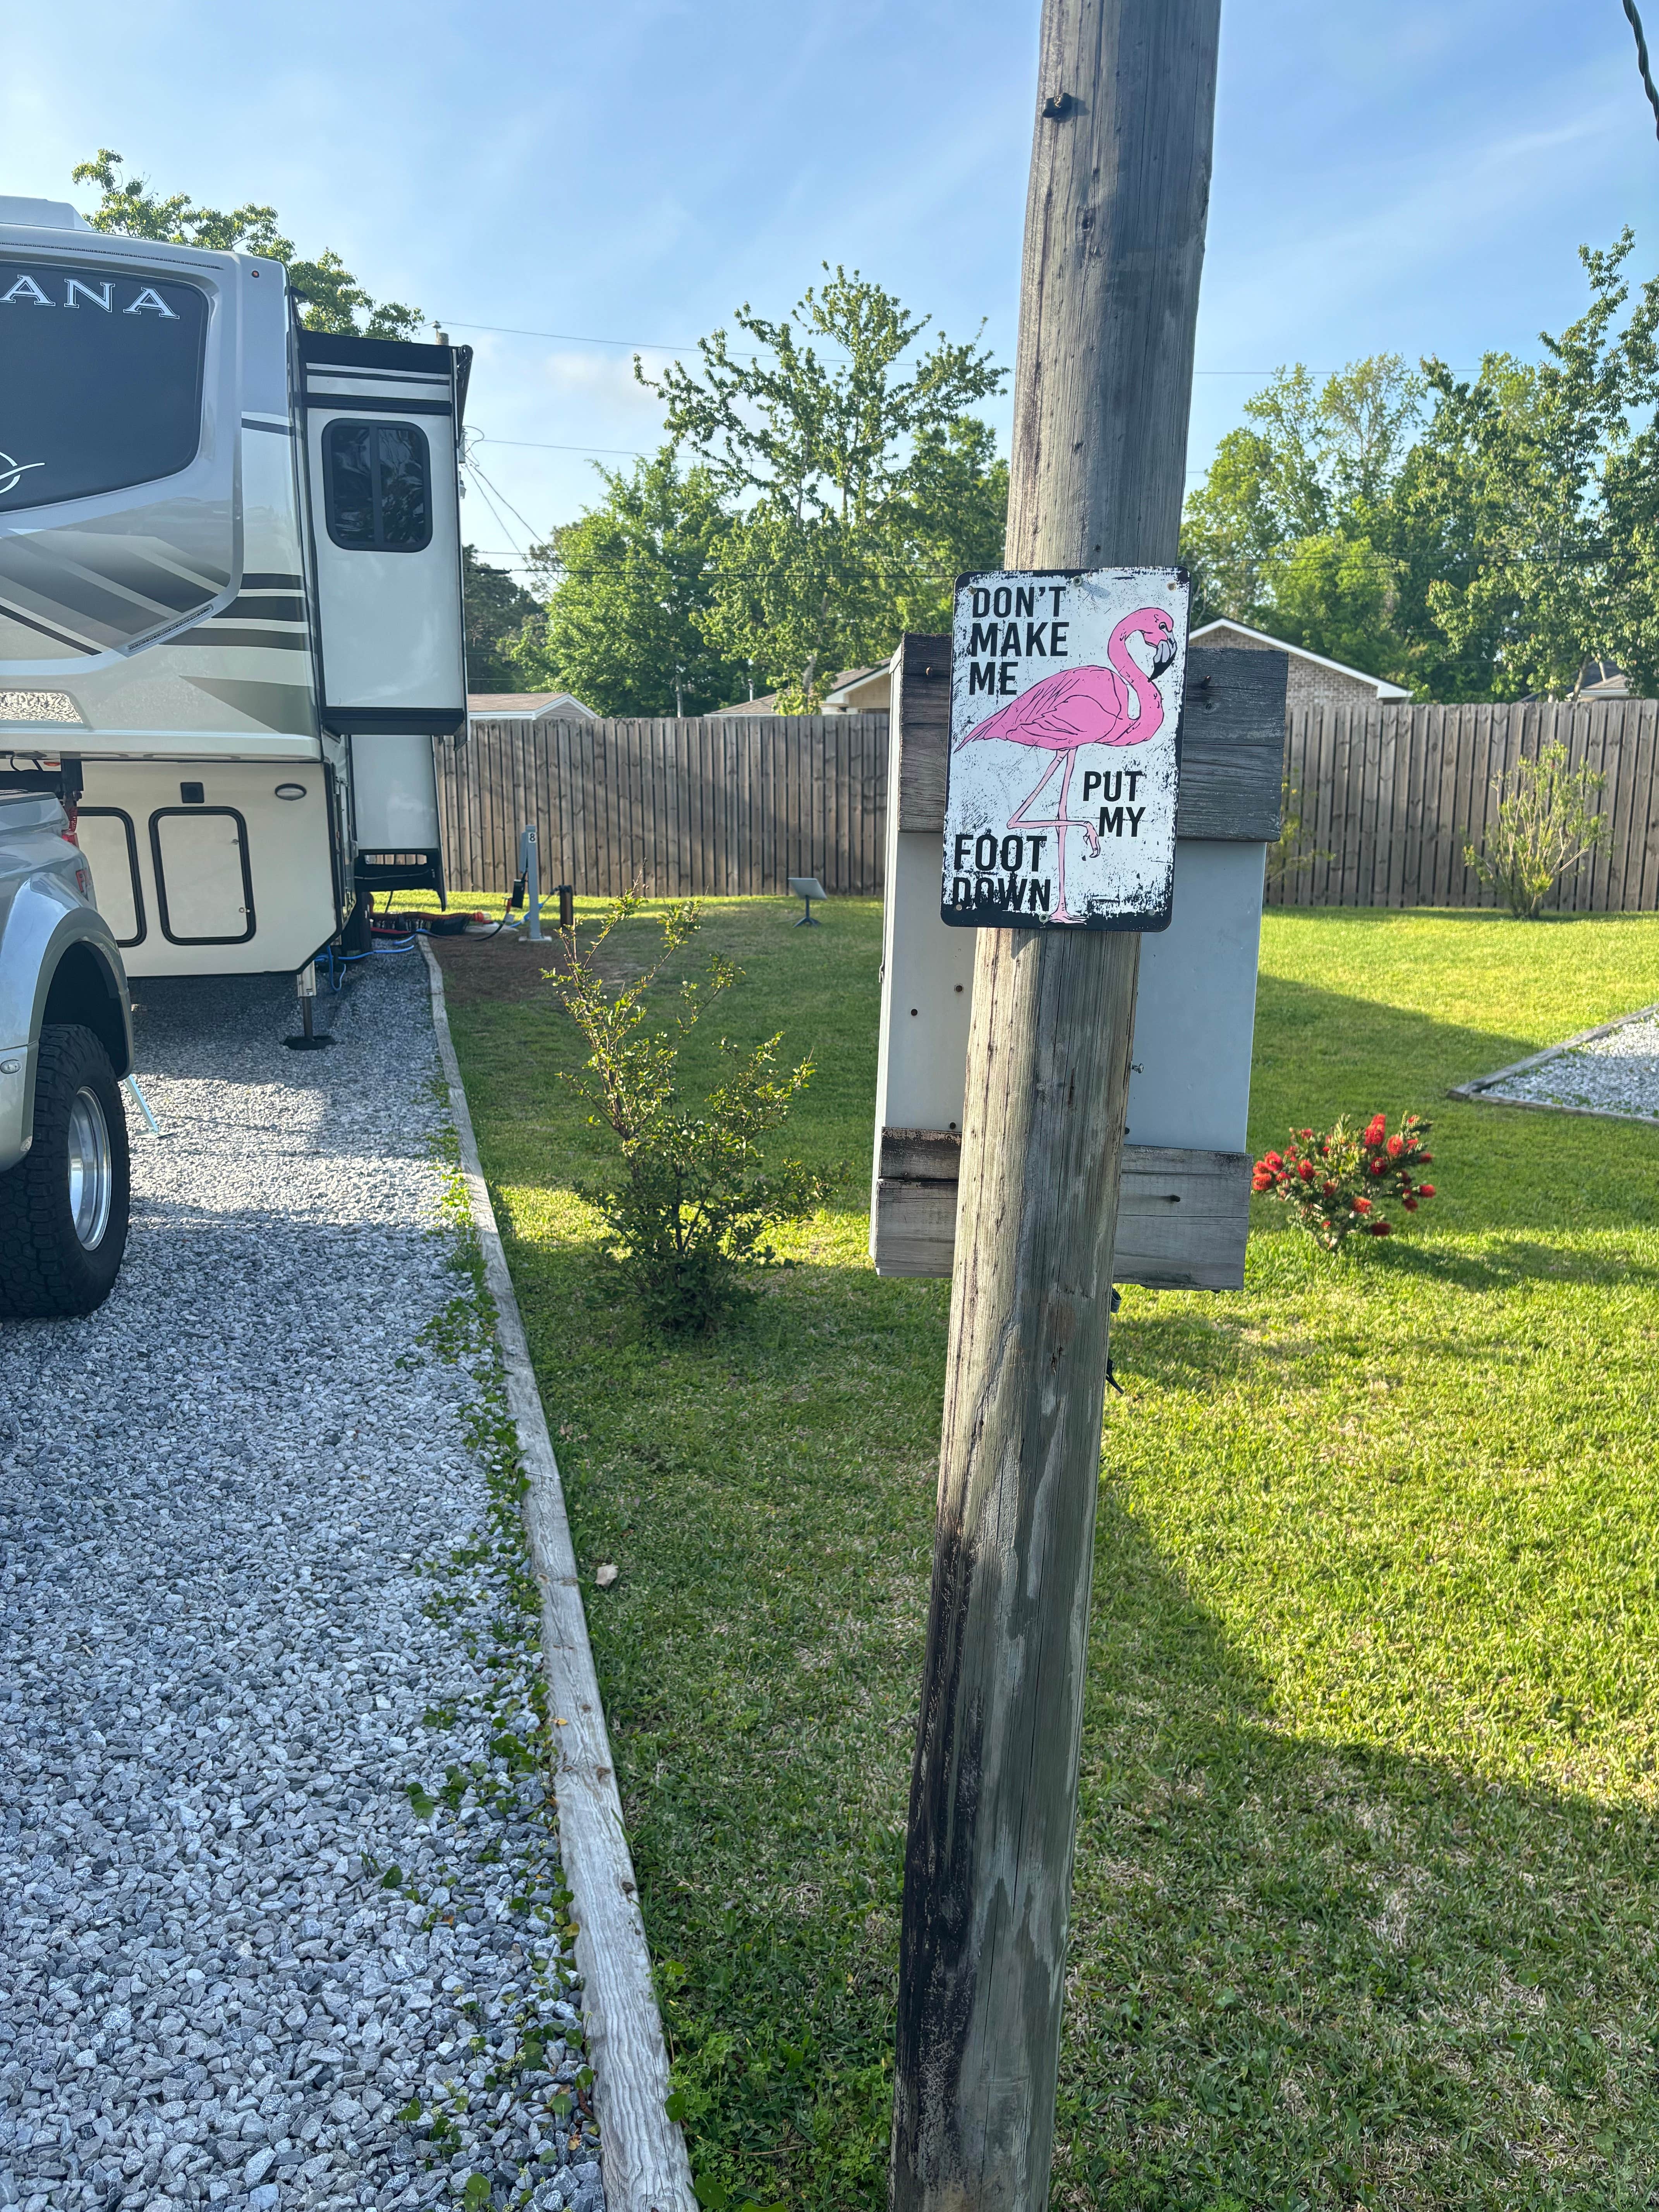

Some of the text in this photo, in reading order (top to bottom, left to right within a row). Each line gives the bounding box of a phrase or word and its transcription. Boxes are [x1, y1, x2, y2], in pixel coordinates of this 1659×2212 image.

[972, 586, 1066, 618] DON'T
[970, 622, 1070, 657] MAKE
[969, 661, 1018, 696] ME
[1083, 771, 1144, 802] PUT
[529, 833, 536, 842] 8
[1098, 807, 1146, 837] MY
[954, 834, 1048, 872] FOOT
[952, 877, 1051, 912] DOWN
